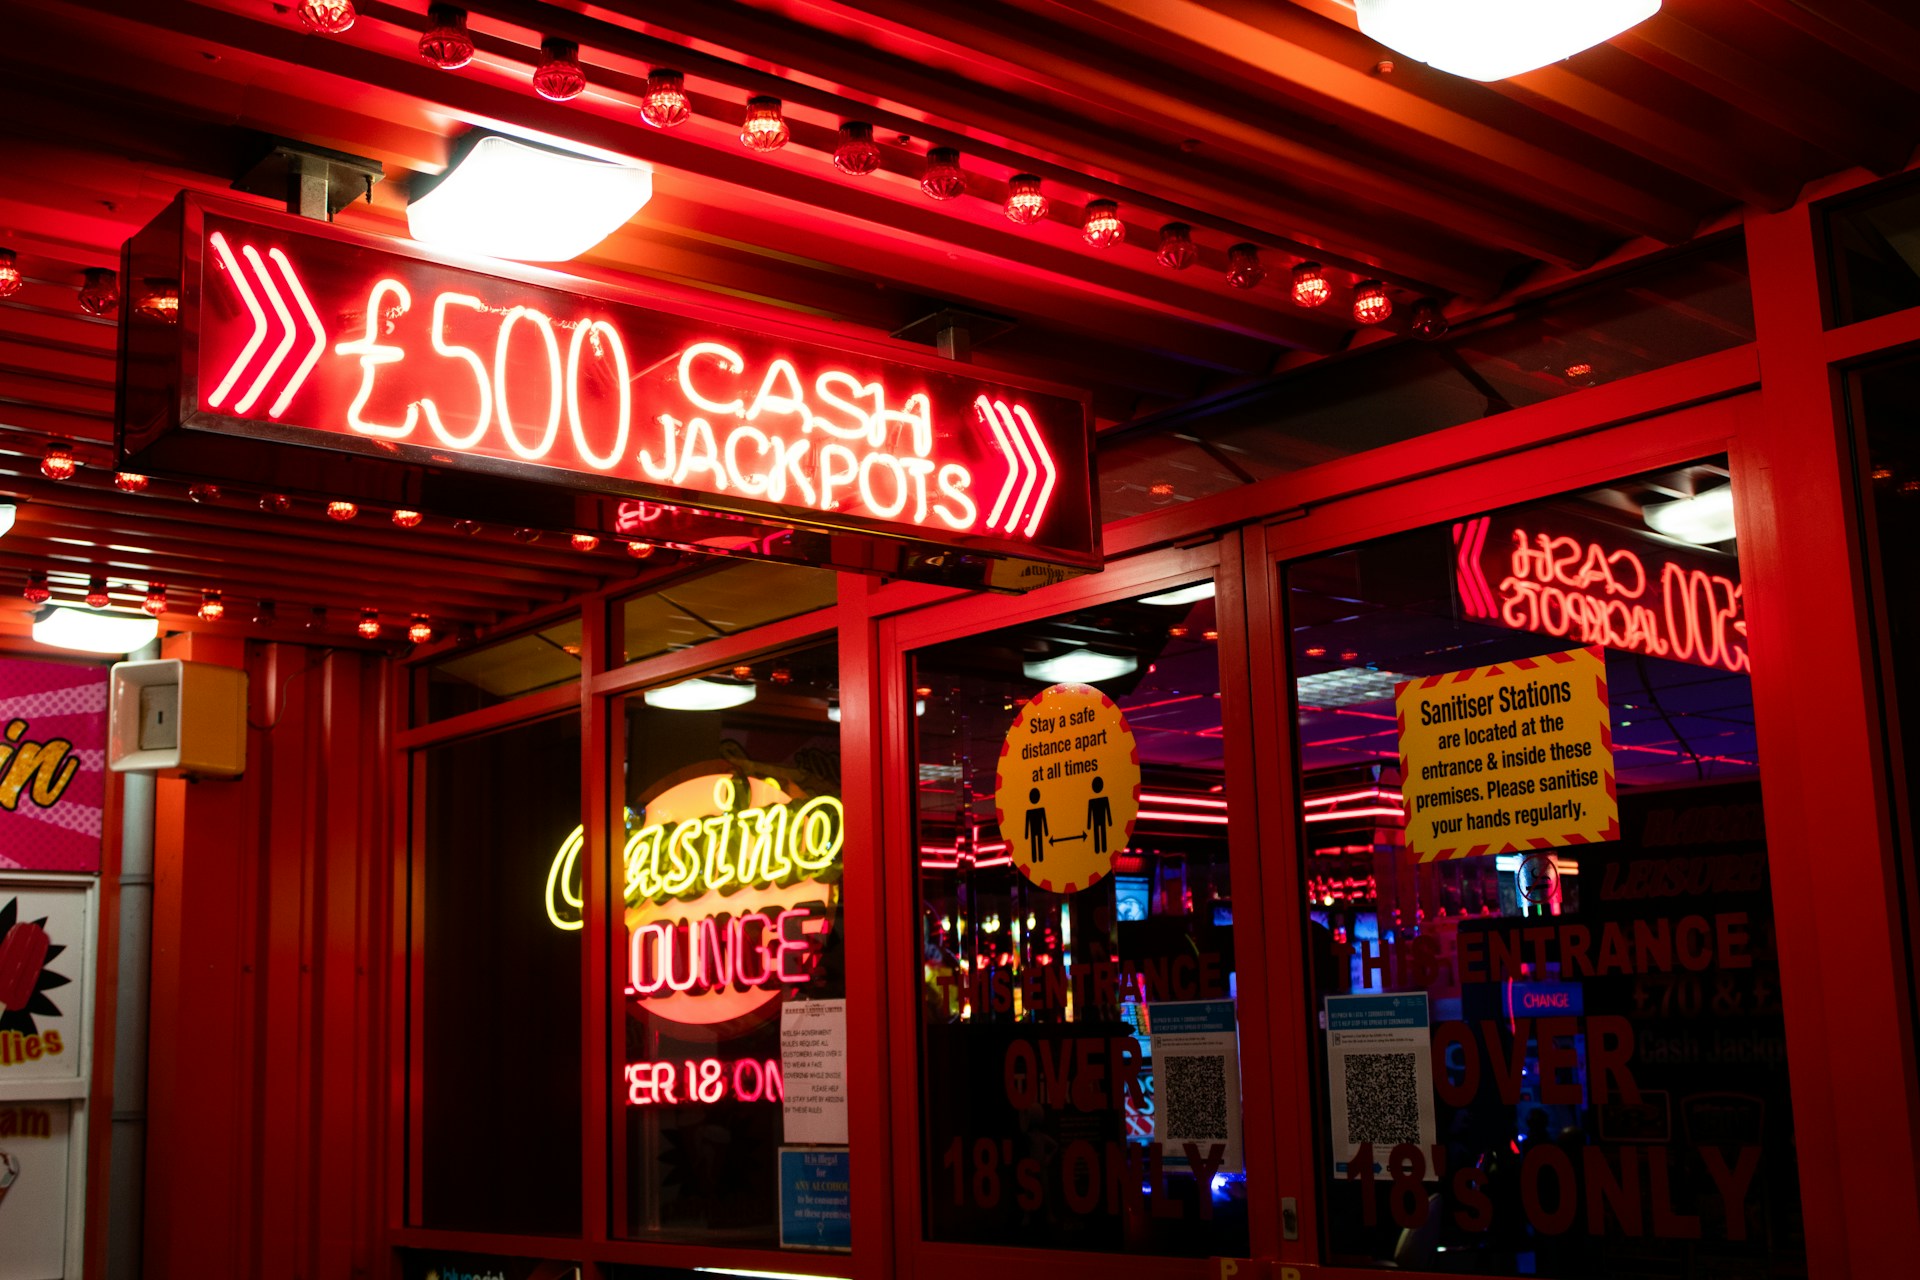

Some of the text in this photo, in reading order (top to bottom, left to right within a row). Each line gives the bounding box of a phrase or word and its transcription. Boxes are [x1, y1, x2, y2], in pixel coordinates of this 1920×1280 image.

[335, 278, 631, 470] £500
[678, 342, 932, 457] CASH
[639, 414, 977, 529] JACKPOTS
[1030, 707, 1095, 735] Stay a safe
[1420, 681, 1571, 726] Sanitiser Stations
[1021, 729, 1107, 760] distance apart
[1438, 714, 1564, 750] are located at the
[1032, 758, 1099, 783] at all times
[1421, 741, 1592, 780] entrance & inside these
[1416, 768, 1599, 813] premises. Please sanitise
[1431, 799, 1587, 839] your hands regularly.
[545, 777, 844, 930] Casino
[1600, 852, 1766, 900] LEISURE
[624, 909, 810, 995] OUNGE
[1330, 912, 1752, 989] THIS ENTRANCE
[937, 954, 1223, 1014] THIS ENTRANCE
[1523, 992, 1570, 1008] CHANGE
[0, 1030, 64, 1066] lies
[1432, 1015, 1645, 1108] OVER
[625, 1063, 677, 1104] ER
[686, 1059, 722, 1103] 18
[1004, 1036, 1146, 1113] OVER
[0, 1107, 51, 1139] am
[816, 1167, 826, 1178] for
[818, 1154, 838, 1166] illegal
[944, 1137, 1226, 1221] 18's ONLY
[804, 1207, 820, 1218] these
[814, 1195, 848, 1206] consumed
[1347, 1142, 1763, 1241] 18's ONLY
